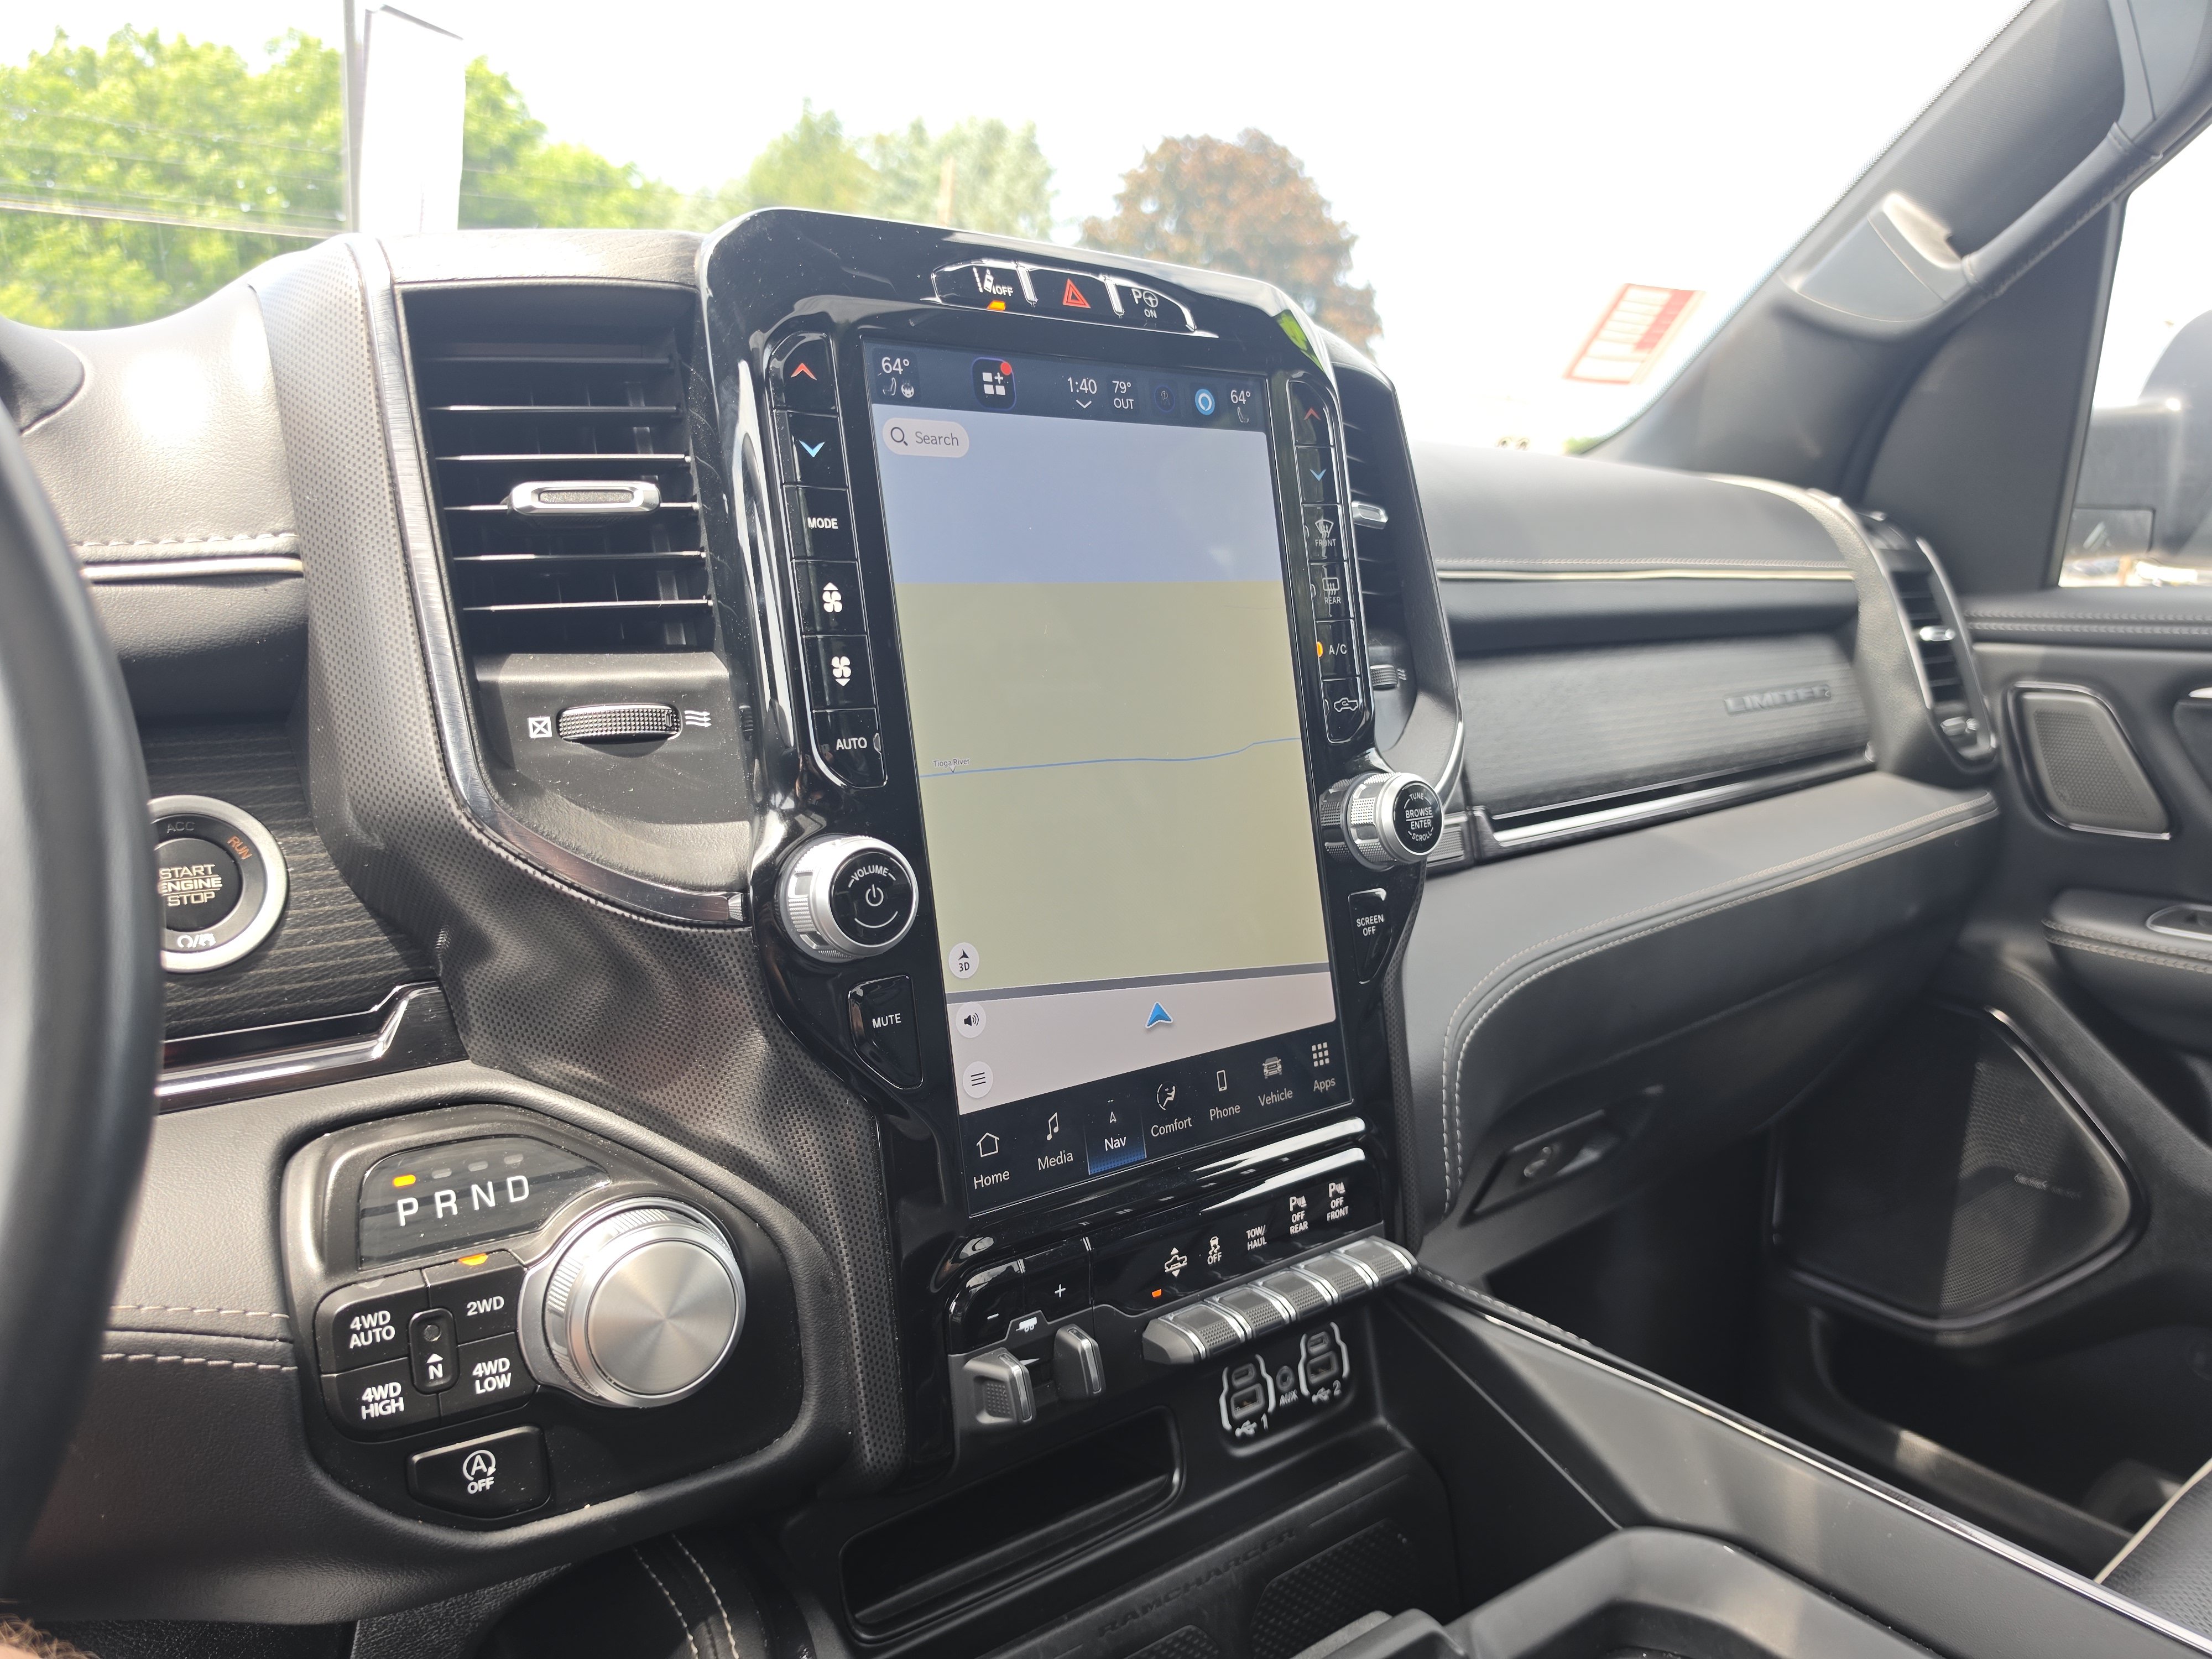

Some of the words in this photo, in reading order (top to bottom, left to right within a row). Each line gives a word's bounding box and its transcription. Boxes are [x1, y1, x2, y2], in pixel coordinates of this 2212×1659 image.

[996, 285, 1014, 297] OFF
[1144, 309, 1157, 319] ON
[881, 357, 910, 374] 64°
[1067, 377, 1097, 394] 1:40
[1112, 380, 1131, 394] 79°
[1114, 398, 1134, 410] OUT
[1230, 389, 1251, 405] 64°
[915, 431, 959, 446] Search
[807, 518, 839, 529] MODE
[1315, 539, 1336, 547] FRONT
[1329, 643, 1347, 655] A/C
[836, 737, 868, 750] AUTO
[1410, 792, 1424, 801] TUNE
[1405, 806, 1433, 817] BROWSE
[166, 822, 195, 833] ACC
[1411, 820, 1431, 830] ENTER
[1411, 831, 1432, 842] SCROLL
[227, 835, 253, 860] RUN
[159, 863, 215, 880] START
[851, 865, 889, 881] VOLUME
[159, 877, 223, 894] ENGINE
[167, 891, 215, 907] STOP
[1357, 914, 1384, 927] SCREEN
[1363, 925, 1376, 936] OFF
[958, 962, 970, 972] 3D
[872, 1013, 901, 1029] MUTE
[1313, 1078, 1336, 1092] Apps
[1258, 1088, 1293, 1107] Vehicle
[1209, 1104, 1241, 1121] Phone
[1151, 1117, 1192, 1137] Comfort
[1104, 1136, 1126, 1151] Nav
[1037, 1150, 1073, 1171] Media
[973, 1170, 1010, 1190] Home
[397, 1197, 419, 1227] P
[435, 1189, 458, 1218] R
[471, 1181, 496, 1211] N
[507, 1175, 530, 1203] D
[1331, 1197, 1344, 1209] OFF
[1291, 1211, 1305, 1223] OFF
[1327, 1206, 1349, 1222] FRONT
[1246, 1225, 1266, 1239] TOW/
[1290, 1221, 1308, 1235] REAR
[1247, 1237, 1267, 1251] HAUL
[1207, 1251, 1222, 1265] OFF
[466, 1296, 504, 1316] 2WD
[350, 1310, 391, 1331] 4WD
[349, 1325, 395, 1349] AUTO
[428, 1363, 444, 1380] N
[472, 1358, 510, 1378] 4WD
[475, 1373, 512, 1394] LOW
[1333, 1380, 1342, 1397] 2
[362, 1382, 402, 1402] 4WD
[361, 1397, 404, 1420] HIGH
[1261, 1413, 1269, 1431] 1
[467, 1477, 494, 1494] OFF
